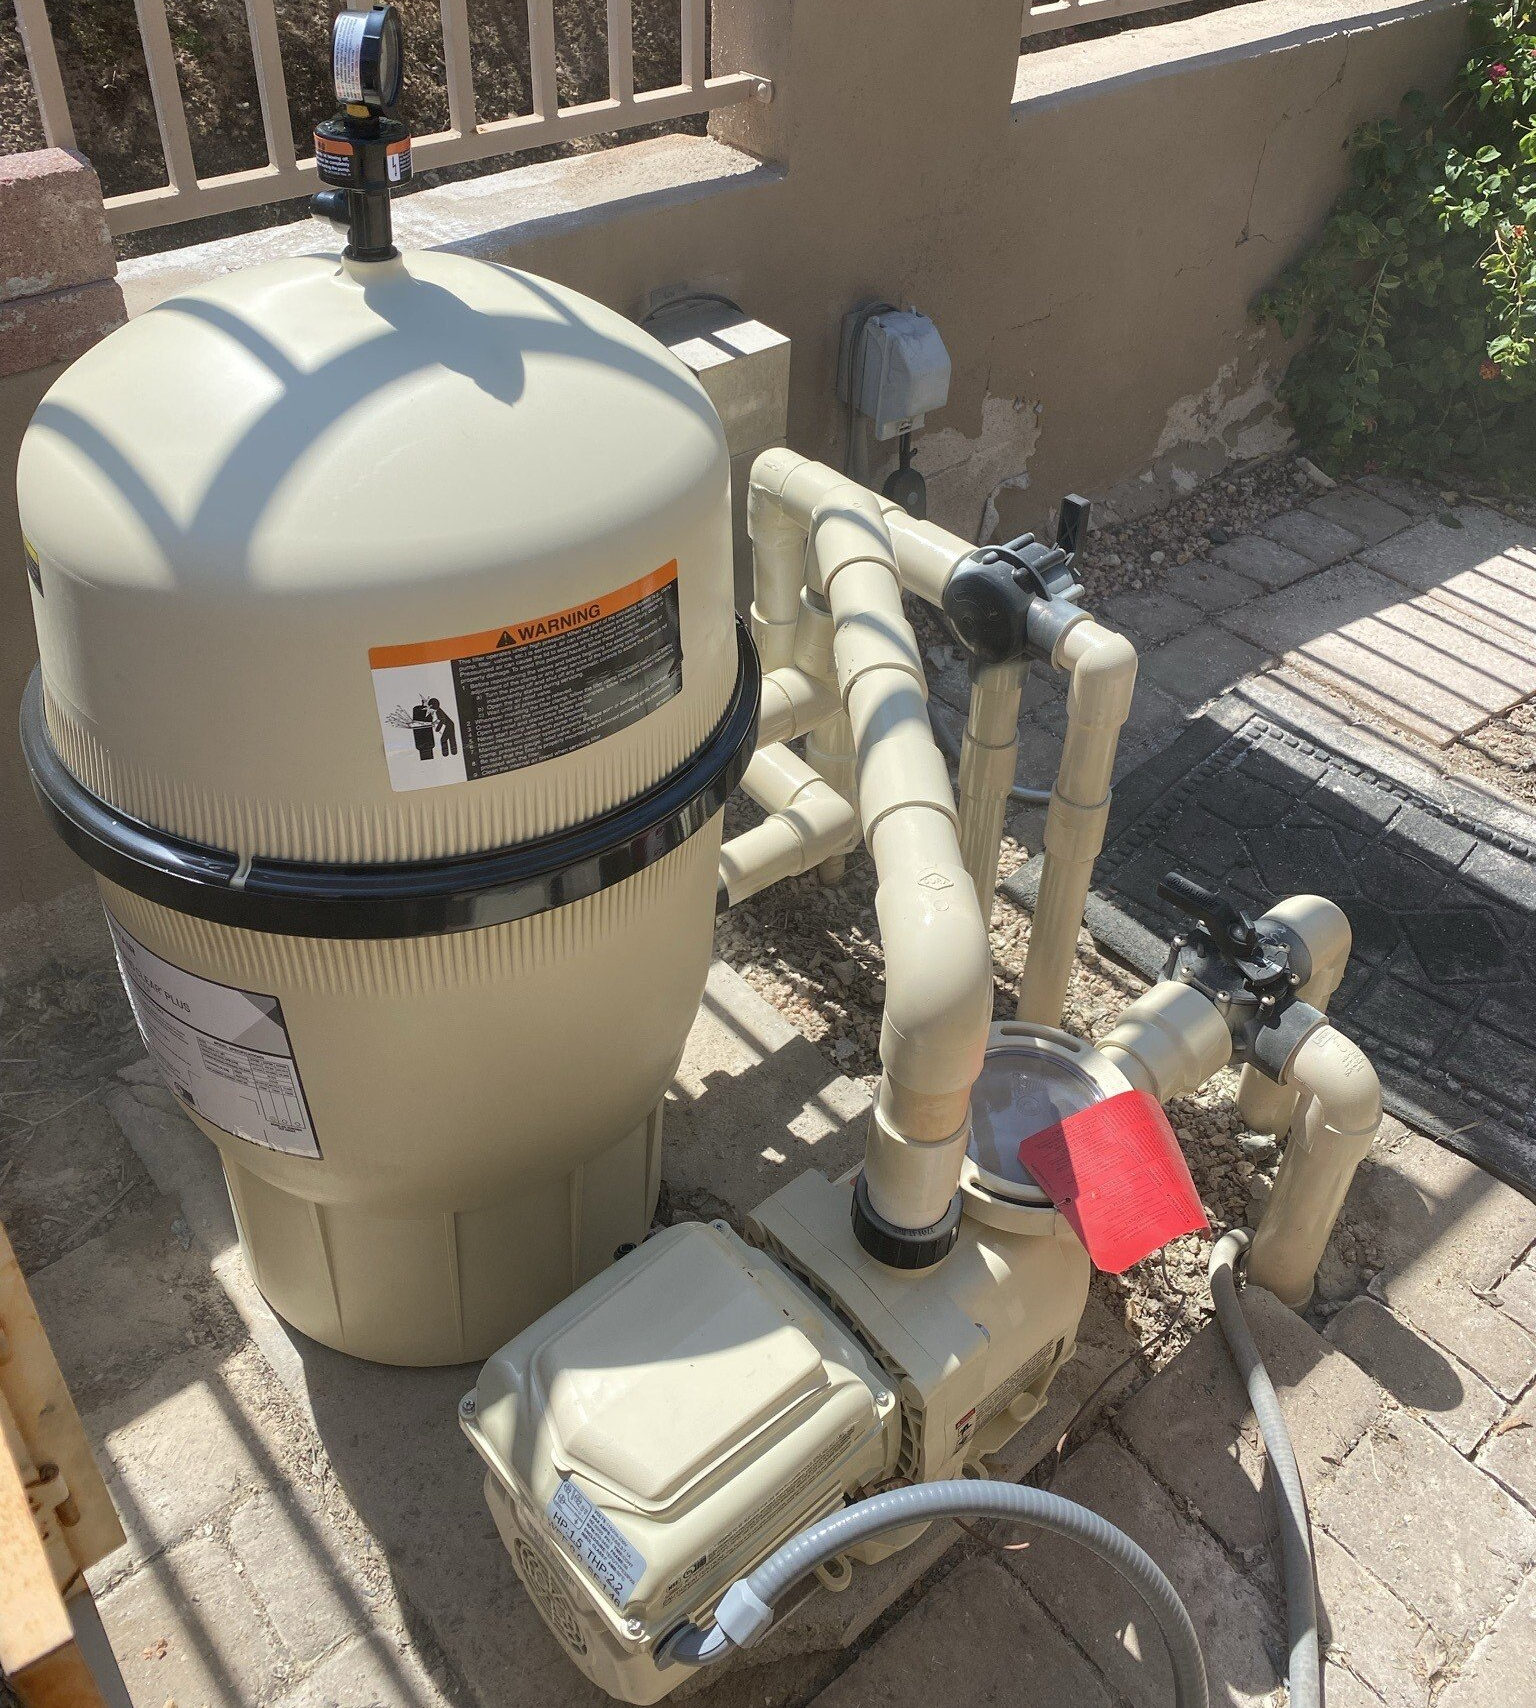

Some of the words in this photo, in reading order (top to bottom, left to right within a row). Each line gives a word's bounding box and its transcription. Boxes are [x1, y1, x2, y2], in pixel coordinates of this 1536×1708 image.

[518, 604, 601, 641] WARNING
[164, 990, 191, 1013] PLUS
[553, 1512, 583, 1548] HP:1.5
[587, 1549, 623, 1594] THP:2.2
